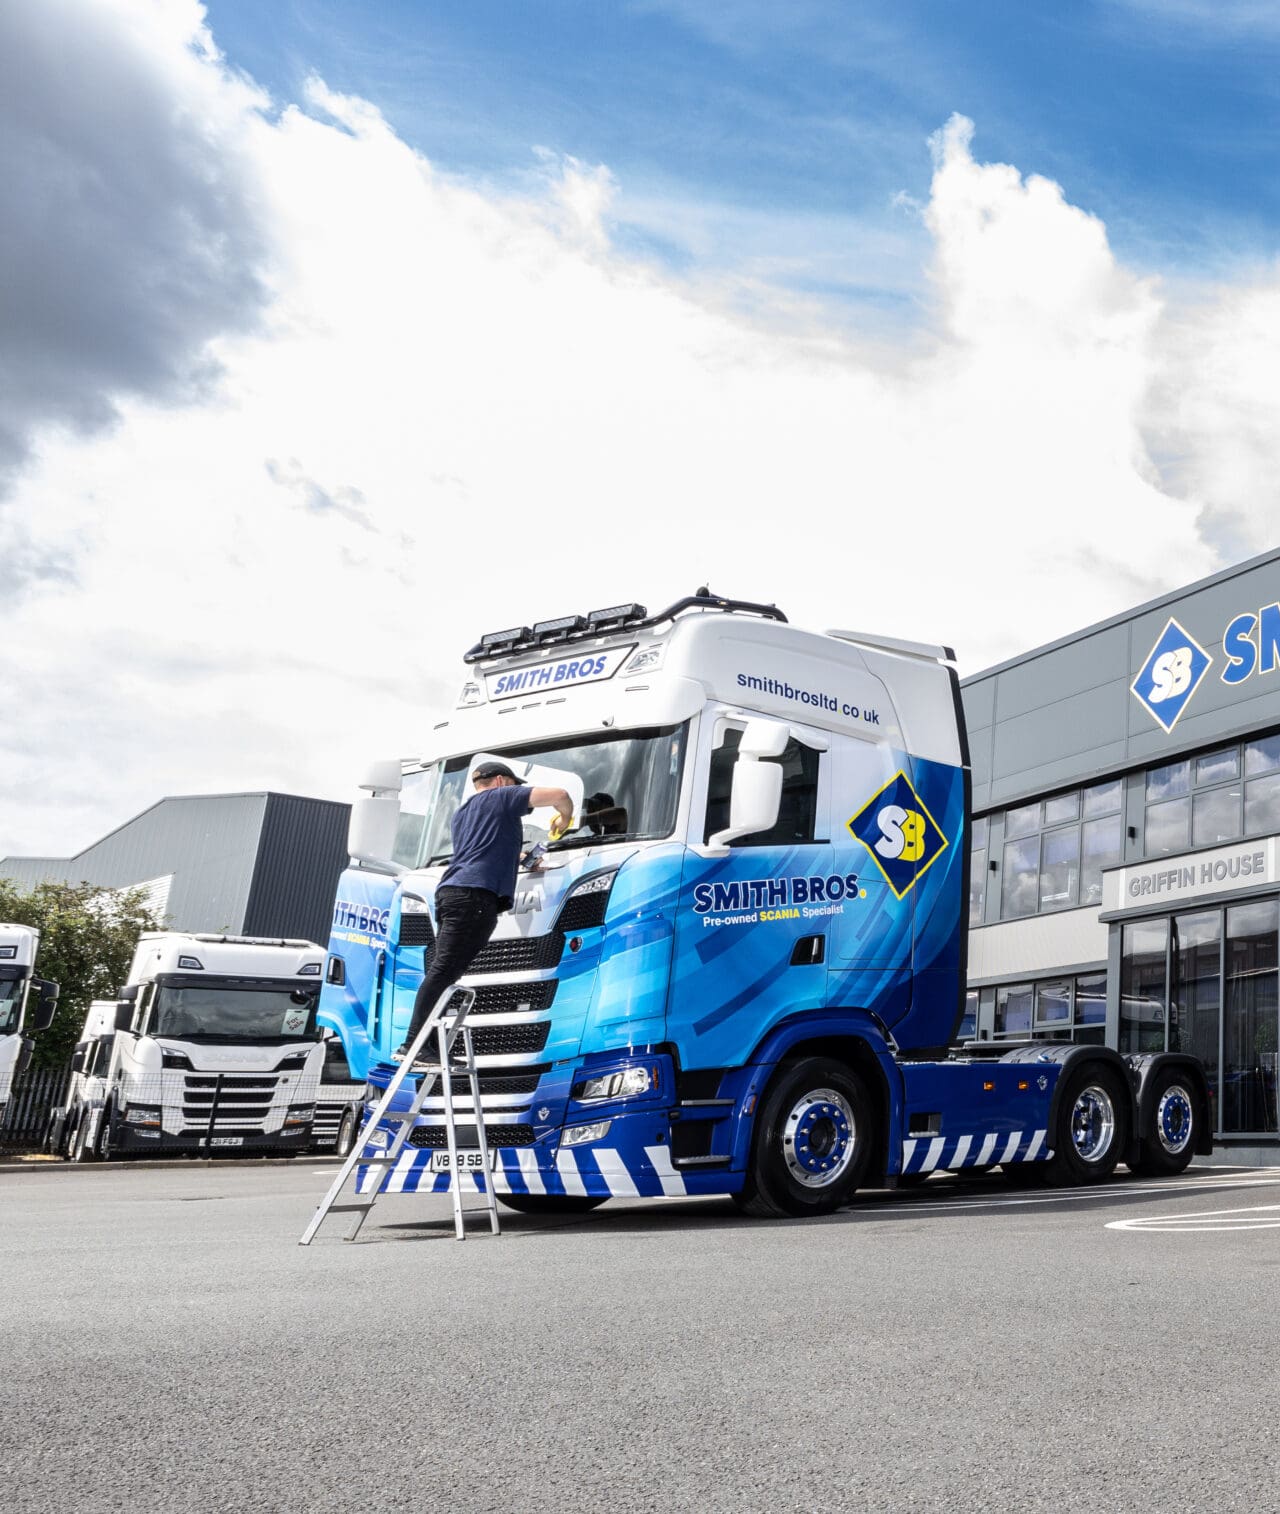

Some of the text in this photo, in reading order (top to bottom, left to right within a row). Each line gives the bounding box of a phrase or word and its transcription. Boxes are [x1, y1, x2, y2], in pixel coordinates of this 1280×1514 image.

[494, 655, 607, 695] SMITH BROS
[1147, 646, 1193, 704] SB
[737, 673, 880, 725] smithbrosltd.co.uk
[874, 804, 926, 862] SB
[693, 872, 867, 914] SMITH BROS.
[1128, 851, 1265, 897] GRIFFIN HOUSE
[703, 904, 844, 927] Pre-owned SCANIA Specialist
[436, 1153, 492, 1167] V88 SB
